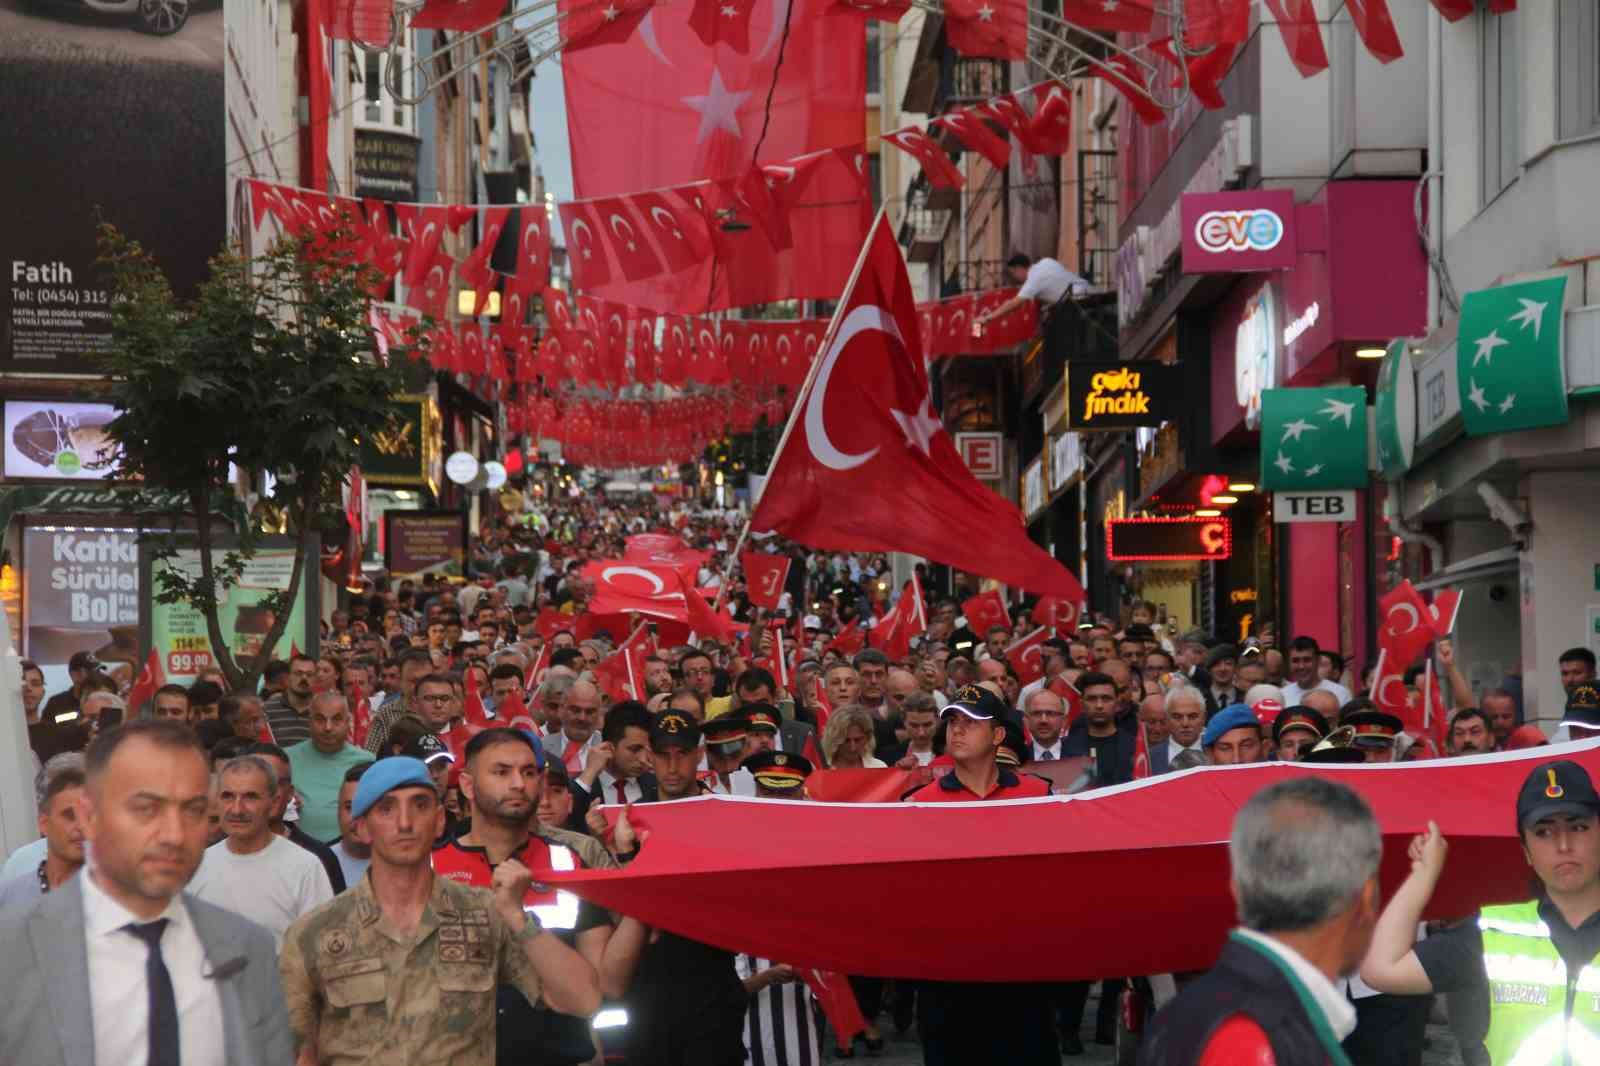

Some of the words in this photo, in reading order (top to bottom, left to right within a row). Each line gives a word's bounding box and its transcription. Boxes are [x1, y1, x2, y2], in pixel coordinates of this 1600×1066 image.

[1197, 211, 1283, 251] eve
[12, 261, 72, 283] Fatih
[12, 288, 34, 301] Tel:
[38, 288, 79, 304] (0454)
[969, 442, 991, 469] E
[1285, 497, 1345, 515] TEB
[72, 593, 117, 622] Bol
